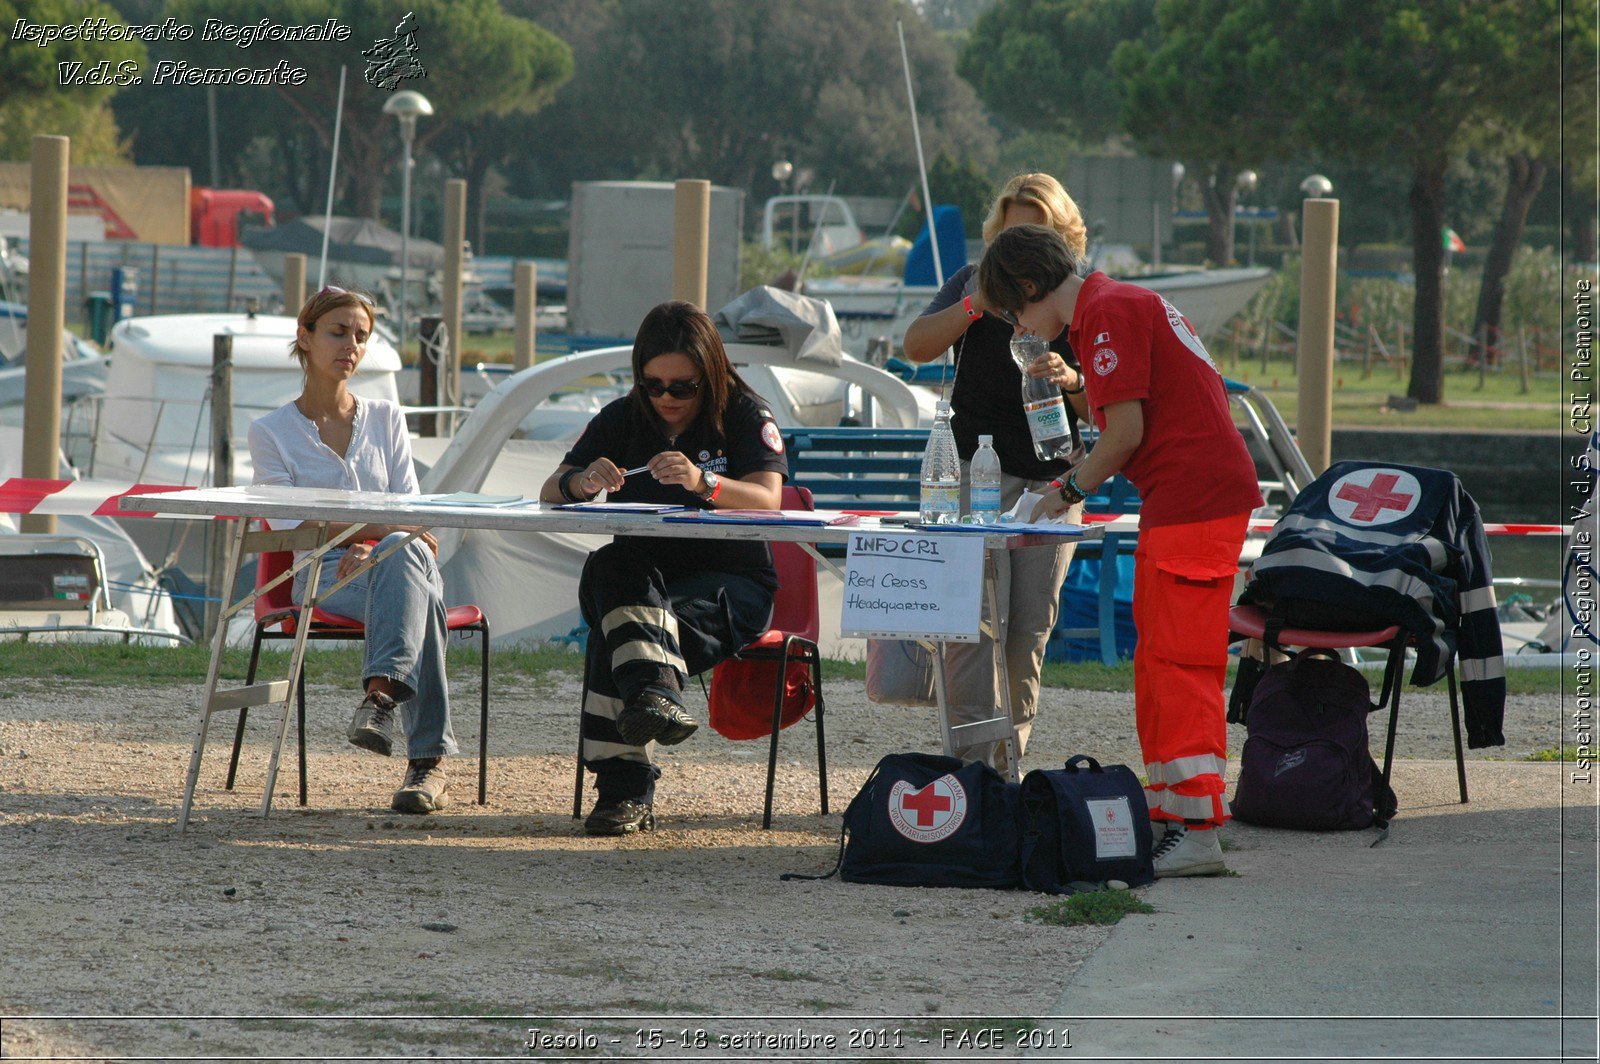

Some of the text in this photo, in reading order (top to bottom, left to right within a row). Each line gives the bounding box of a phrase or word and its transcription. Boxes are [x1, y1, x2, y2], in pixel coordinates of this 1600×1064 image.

[855, 537, 940, 555] INFO CRI
[848, 570, 875, 588] Red
[891, 807, 919, 838] VOLONTARI
[930, 811, 963, 840] SOCCORSO
